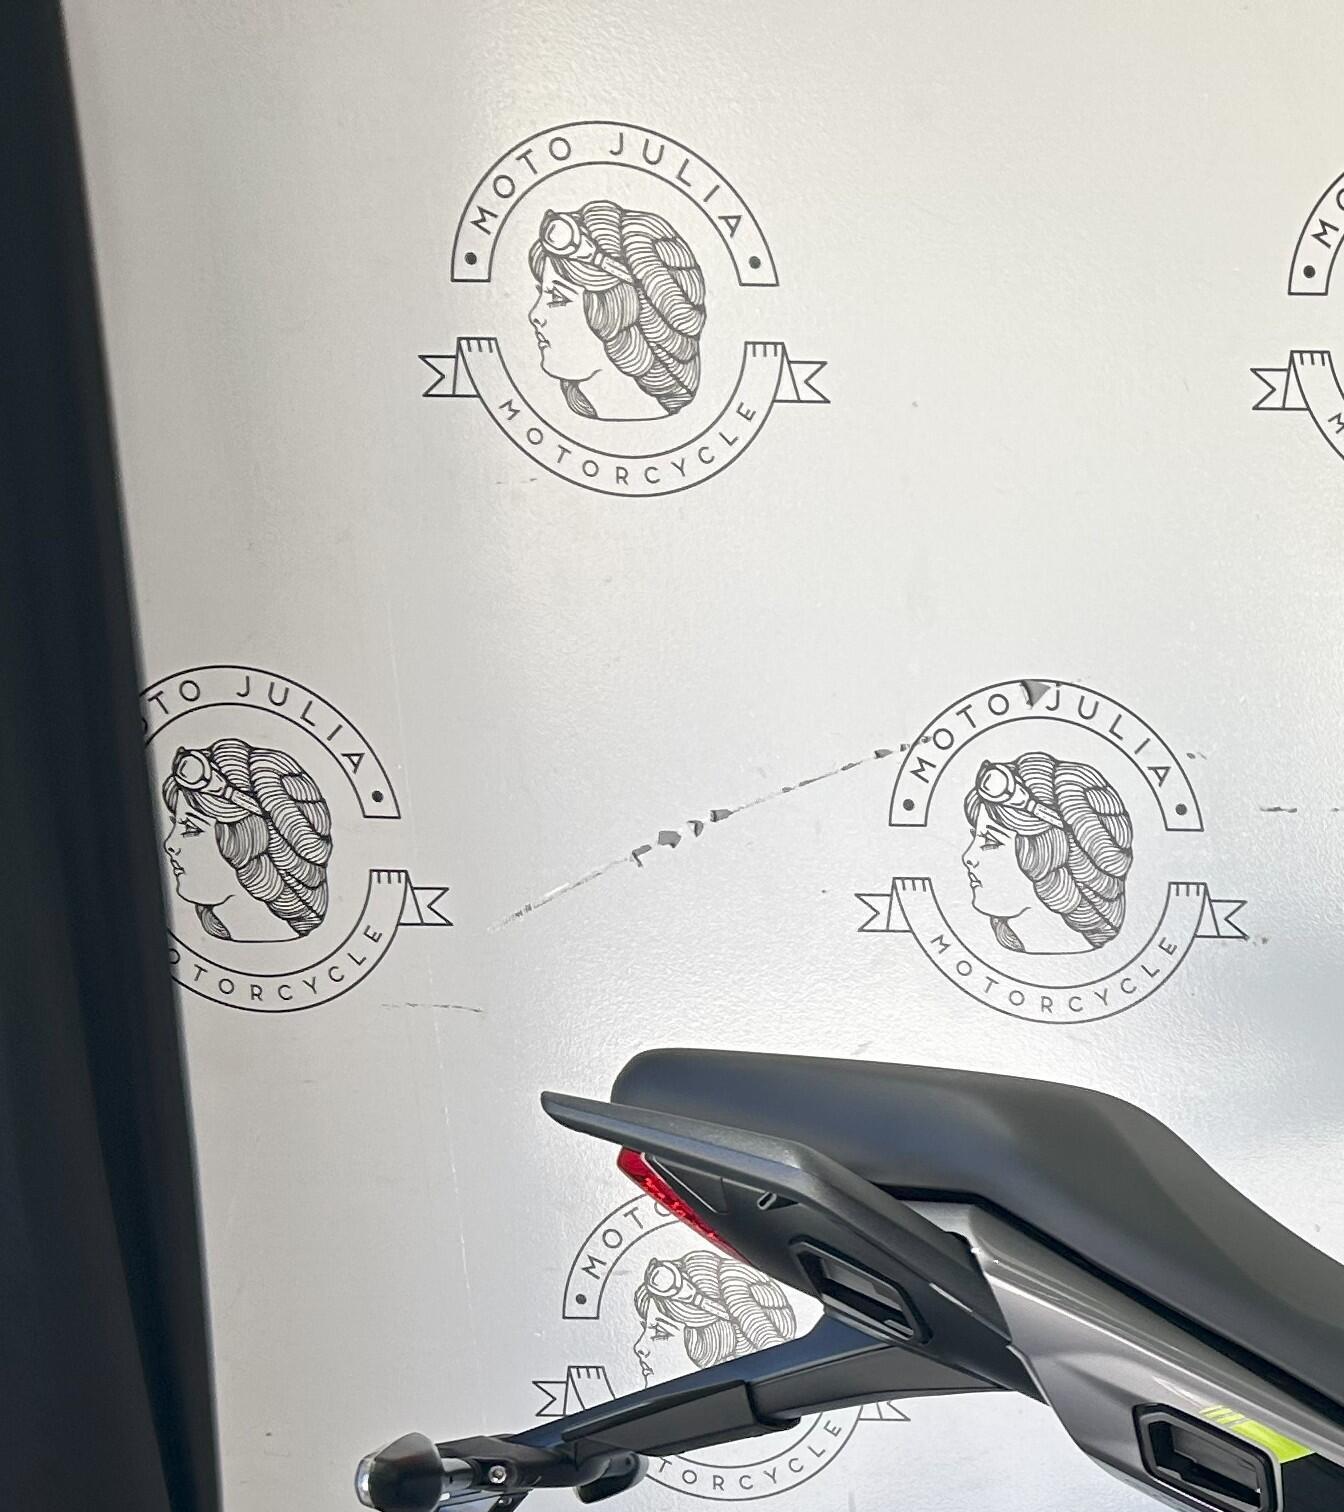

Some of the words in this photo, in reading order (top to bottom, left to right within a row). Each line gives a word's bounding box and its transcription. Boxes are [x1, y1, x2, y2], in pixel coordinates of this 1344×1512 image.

[470, 136, 572, 235] MOTO
[609, 132, 743, 239] JULIA
[498, 401, 757, 485] MOTORCYCLE
[142, 679, 202, 735] TO
[236, 675, 366, 775] JULIA
[910, 693, 1010, 784] MOTO
[1045, 689, 1172, 788] JULIA
[169, 924, 383, 1002] OTORCYCLE
[930, 933, 1178, 1013] MOTORCYCLE
[655, 1420, 842, 1491] TORCYCLE
